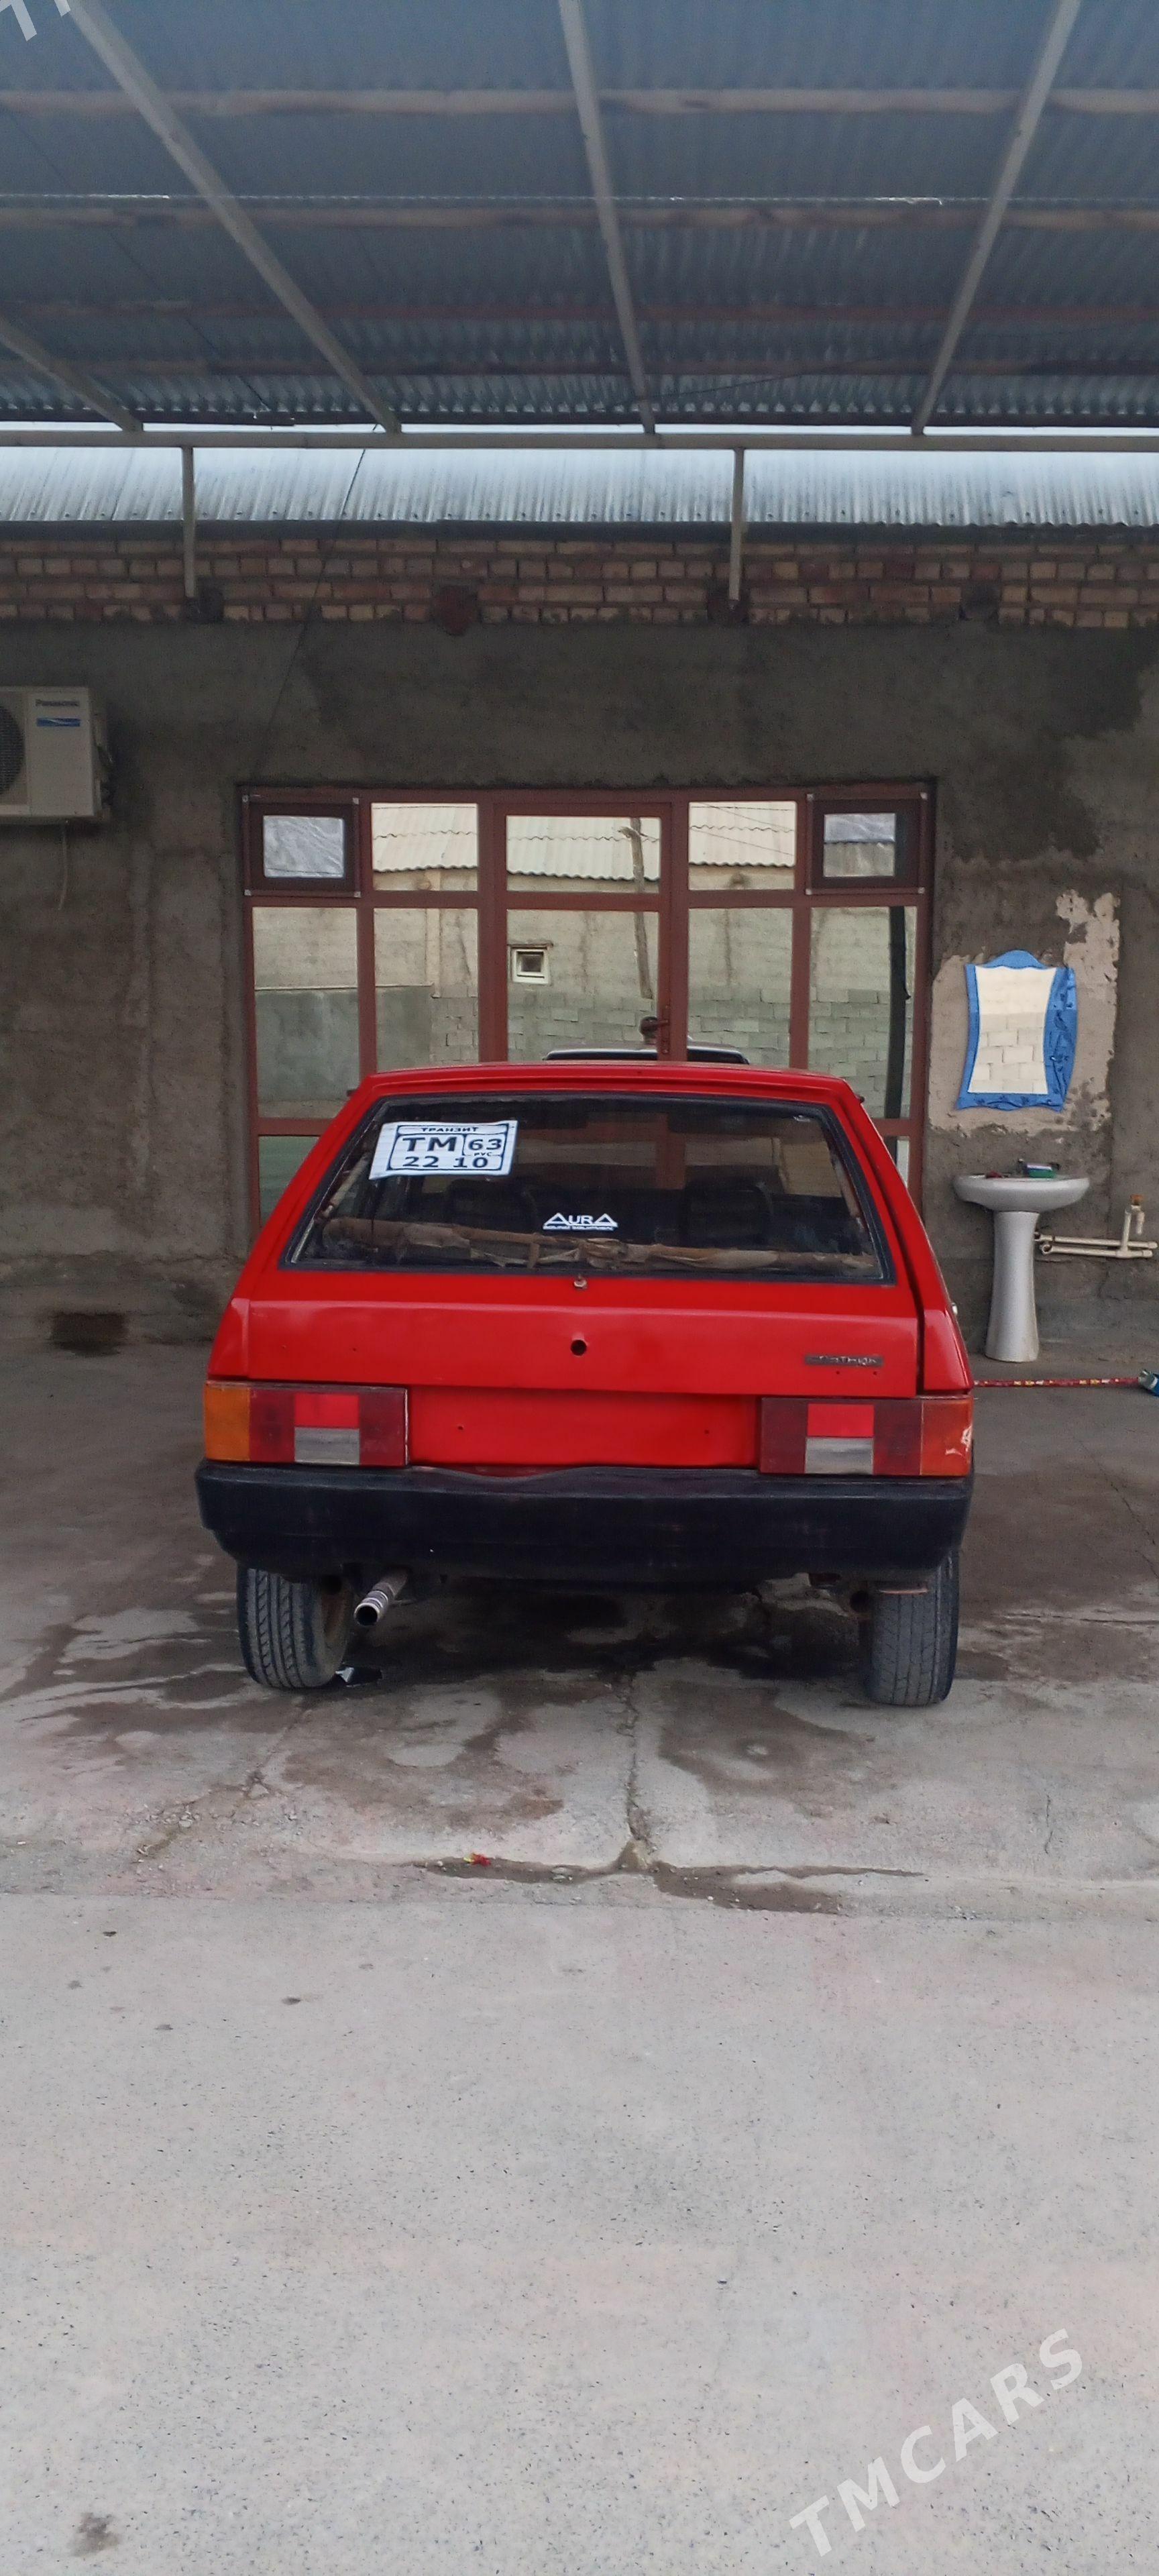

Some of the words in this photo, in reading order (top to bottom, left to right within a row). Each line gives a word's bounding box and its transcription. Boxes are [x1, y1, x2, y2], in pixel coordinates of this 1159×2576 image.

[467, 1138, 502, 1150] 63
[402, 1156, 439, 1168] 22
[453, 1157, 488, 1168] 10
